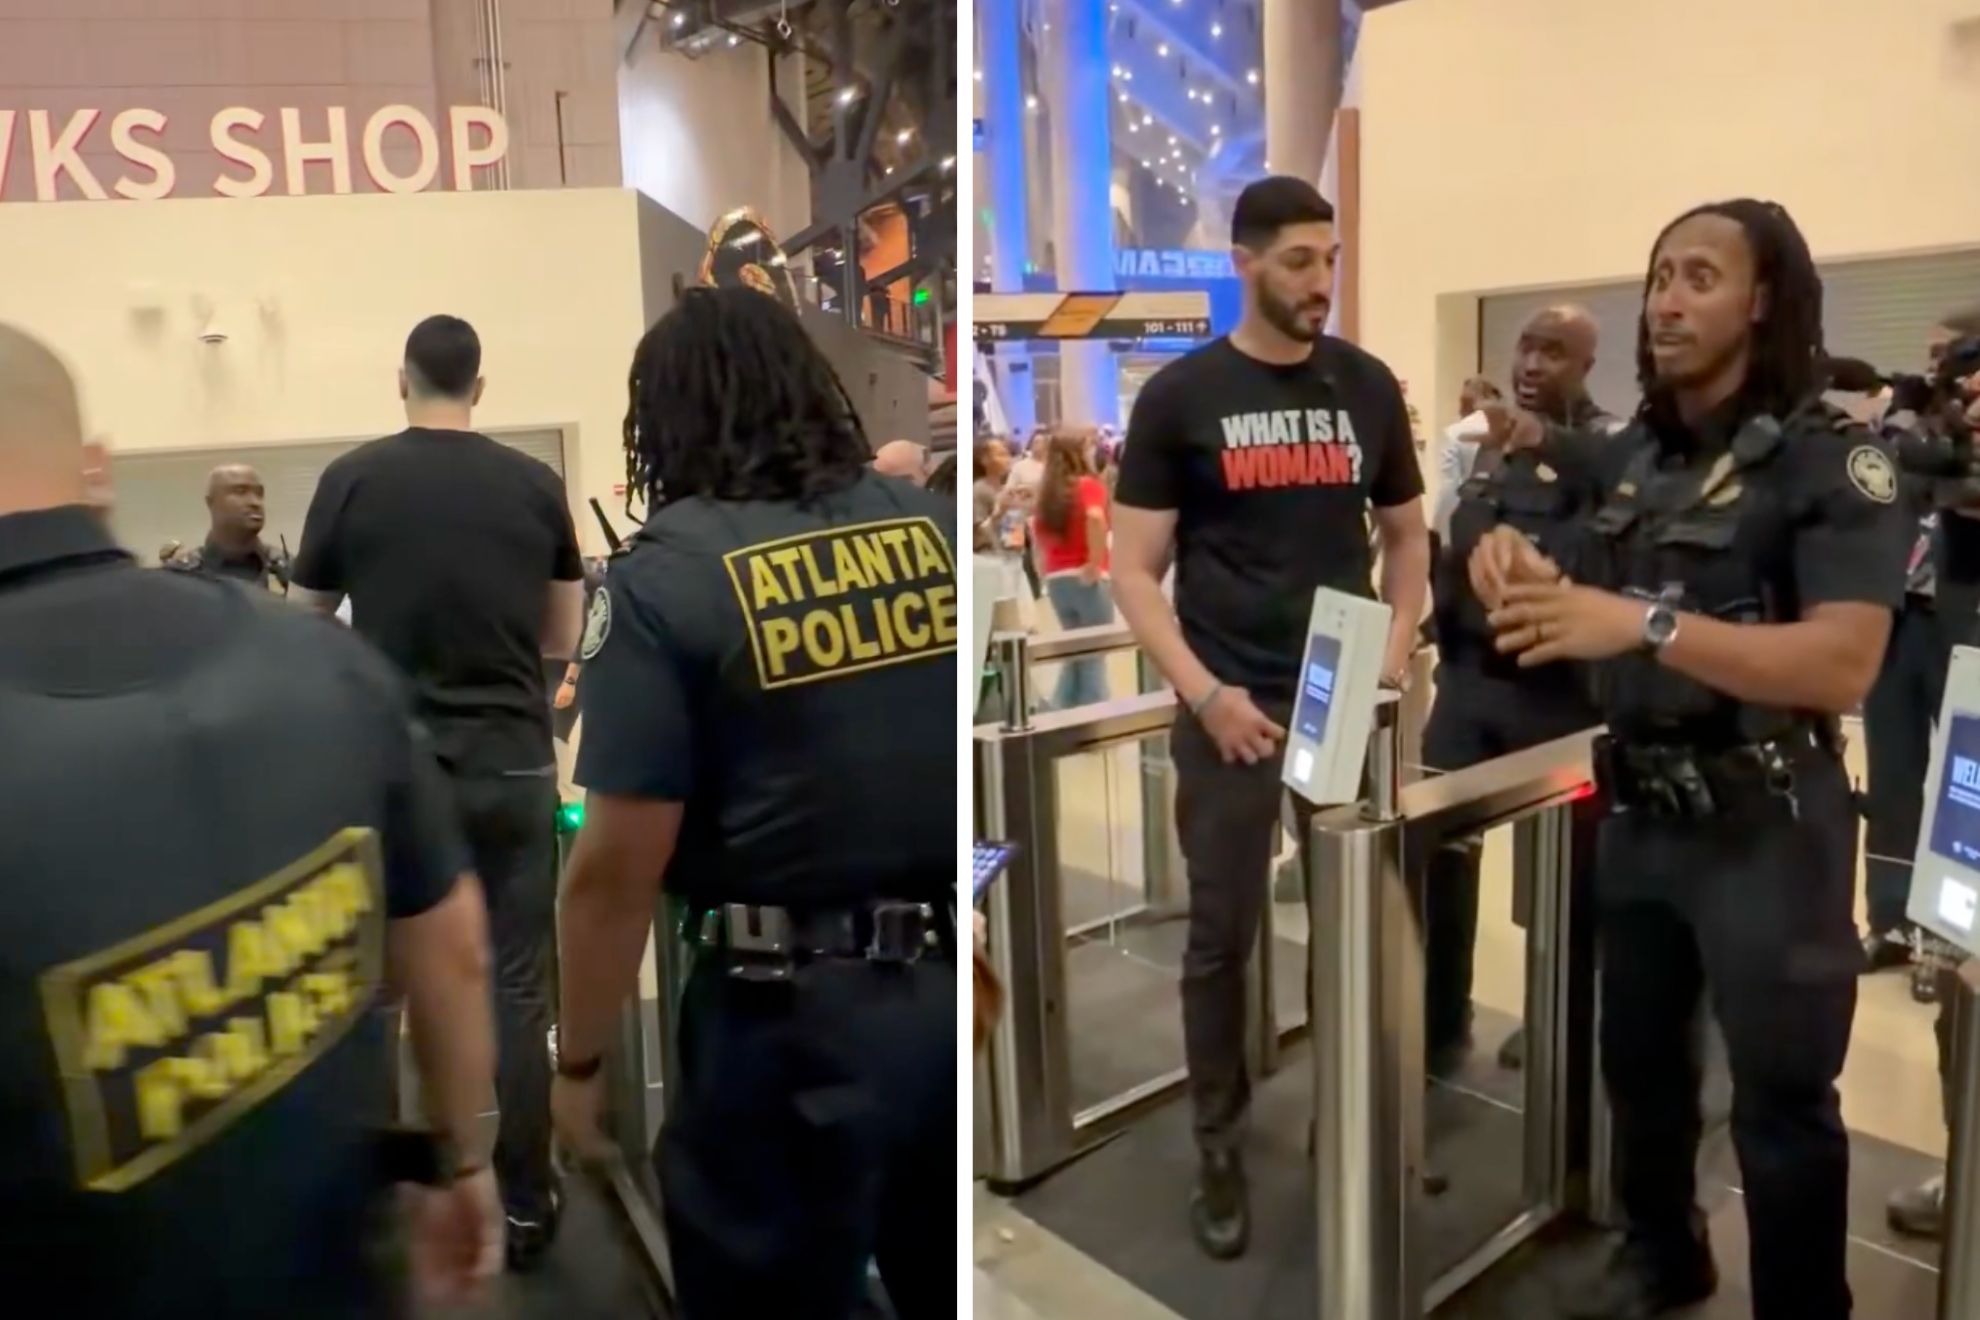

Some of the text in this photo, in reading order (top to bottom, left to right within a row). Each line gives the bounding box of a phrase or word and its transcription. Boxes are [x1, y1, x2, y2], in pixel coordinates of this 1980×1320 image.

[0, 105, 509, 201] KS SHOP
[1220, 409, 1356, 448] WHAT IS A
[1221, 443, 1363, 490] WOMAN?
[748, 526, 948, 609] ATLANTA
[761, 585, 957, 676] POLICE
[1952, 756, 1980, 791] WEL
